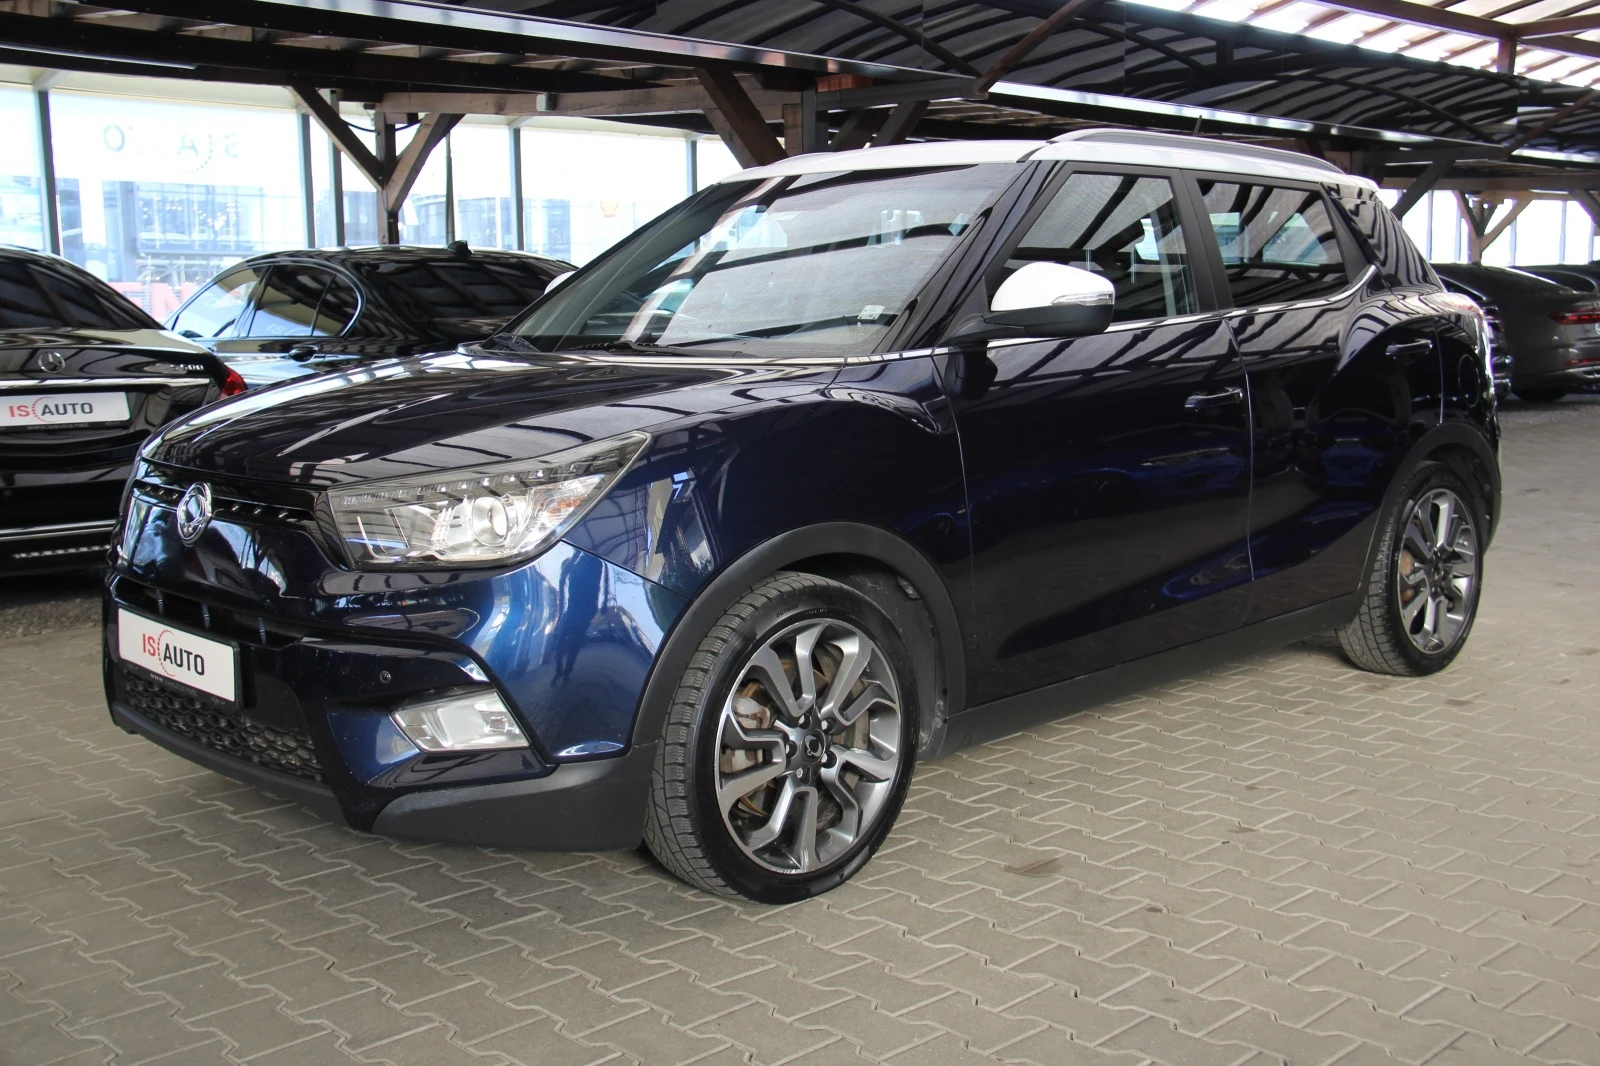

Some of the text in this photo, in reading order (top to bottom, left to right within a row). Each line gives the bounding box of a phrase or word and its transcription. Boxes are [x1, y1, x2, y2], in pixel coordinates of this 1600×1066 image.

[9, 402, 93, 418] IS AUTO
[142, 633, 205, 676] IS AUTO
